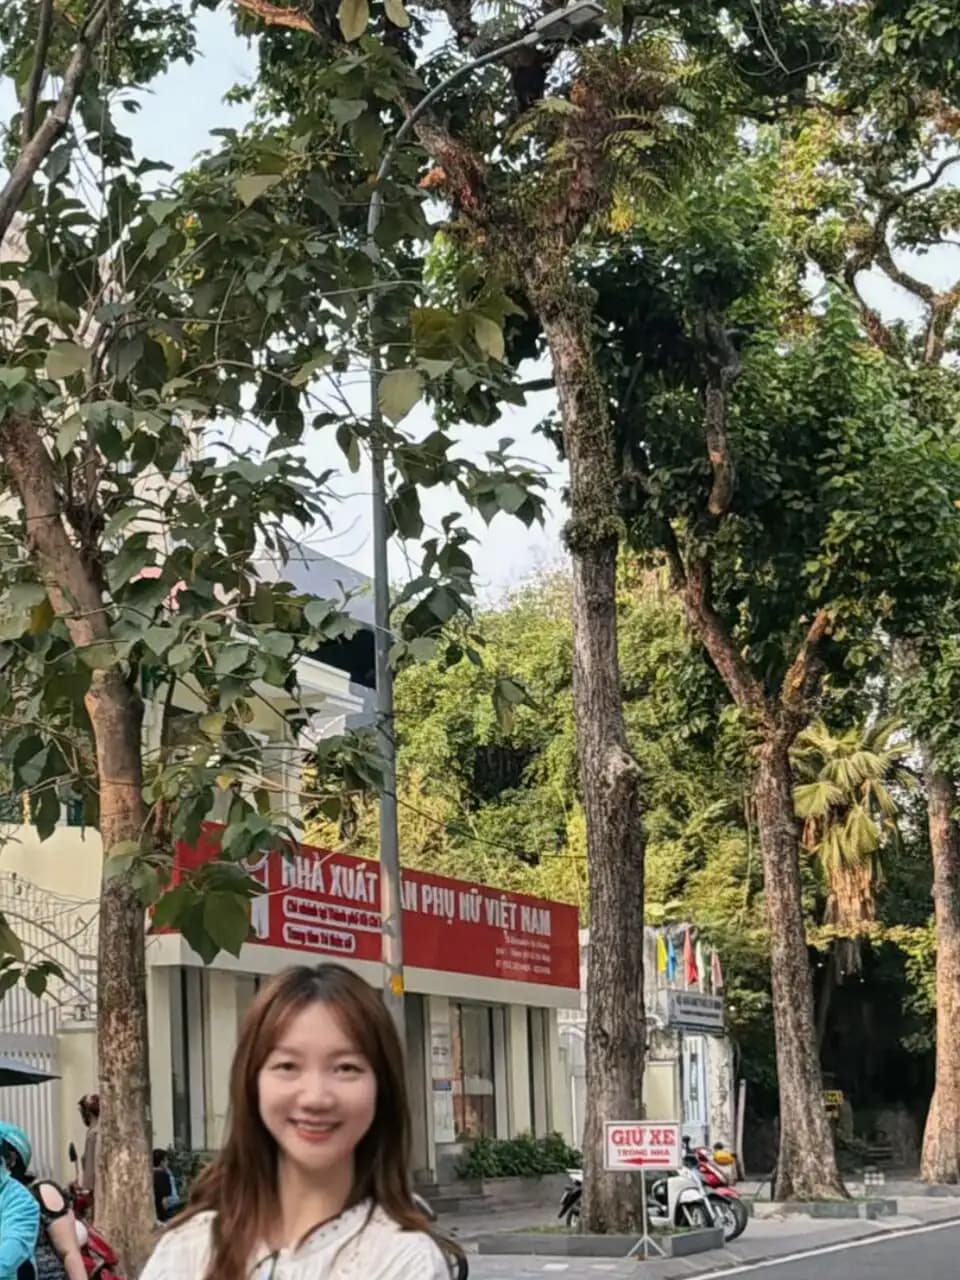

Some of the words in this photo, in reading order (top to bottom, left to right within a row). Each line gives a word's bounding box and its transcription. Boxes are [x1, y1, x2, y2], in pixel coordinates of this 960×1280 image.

[281, 851, 325, 894] NHÀ
[329, 862, 378, 904] XUẤT
[421, 884, 454, 925] PHỤ
[459, 888, 483, 923] NỮ
[485, 894, 517, 933] VIỆT
[520, 905, 551, 936] NAM
[649, 1129, 675, 1146] XE
